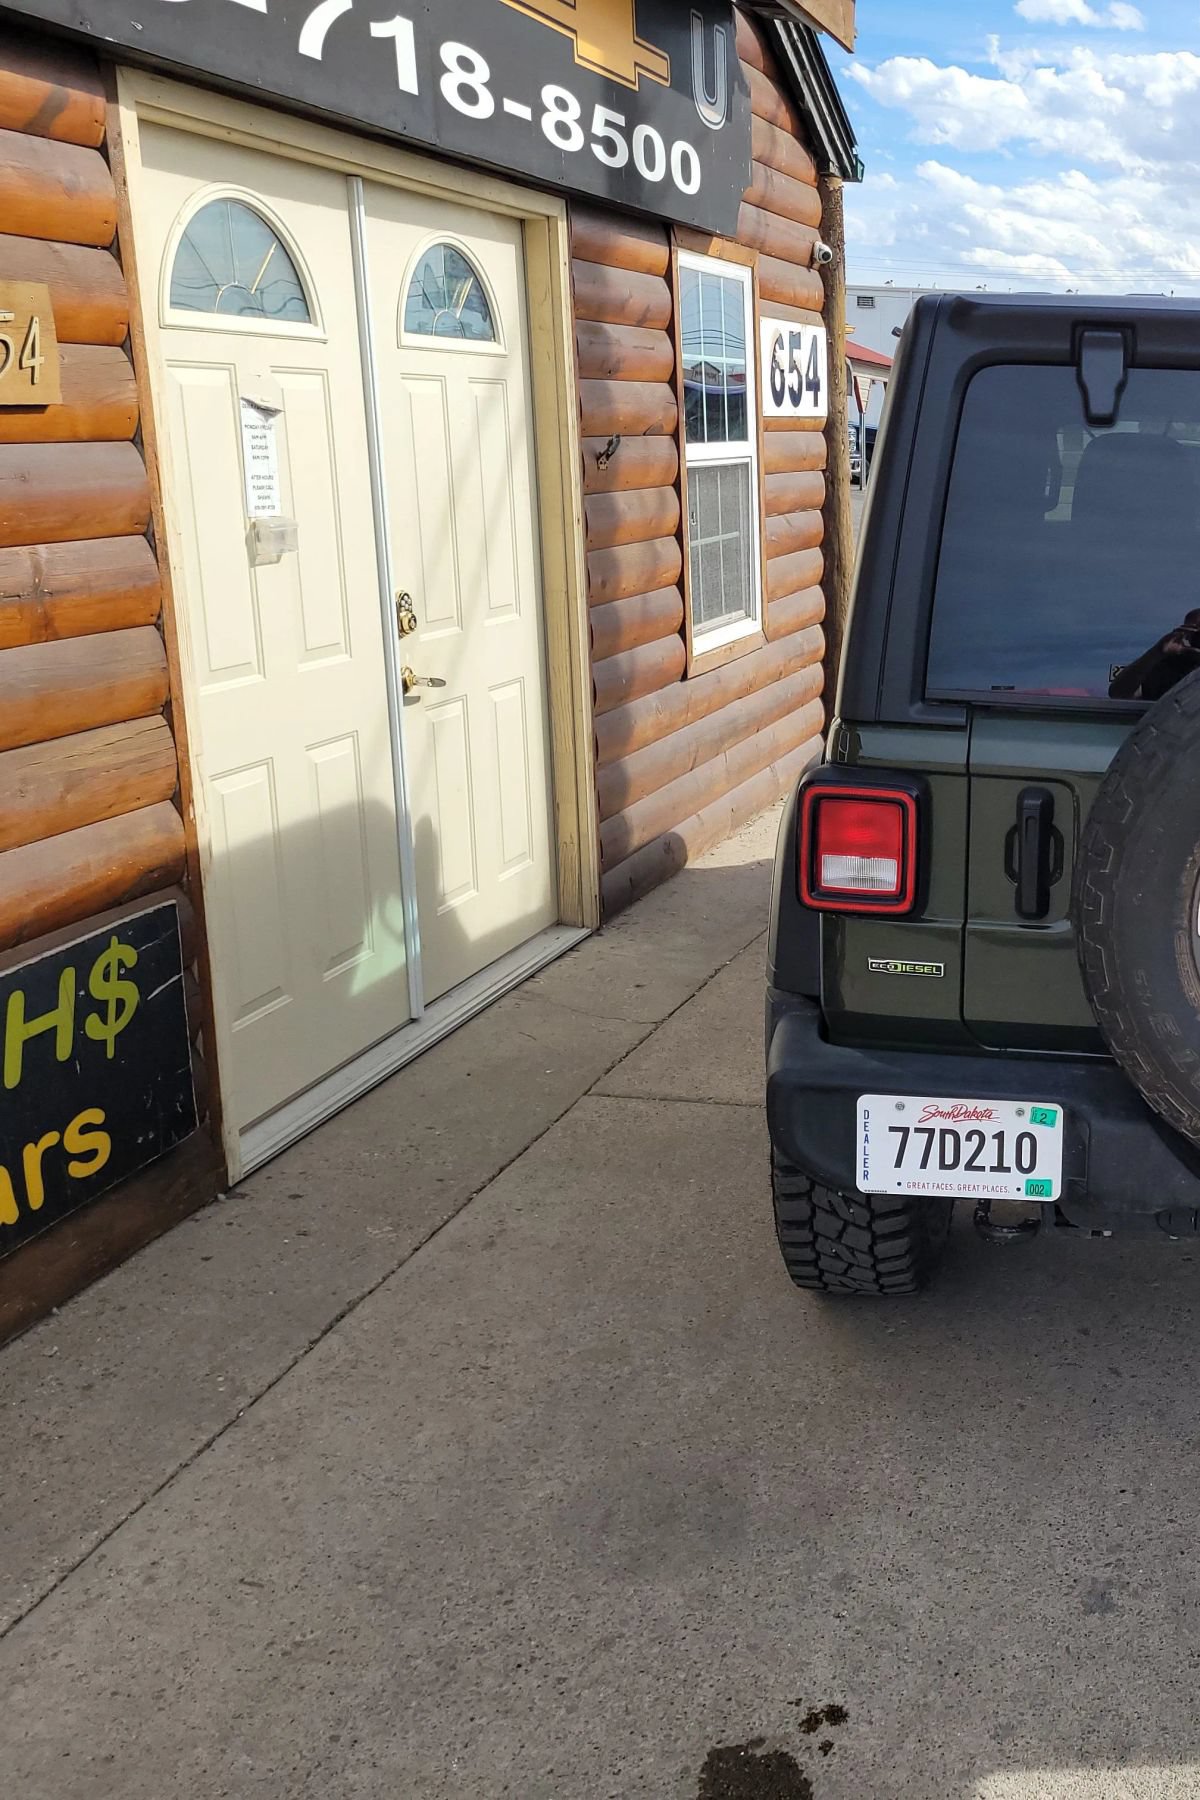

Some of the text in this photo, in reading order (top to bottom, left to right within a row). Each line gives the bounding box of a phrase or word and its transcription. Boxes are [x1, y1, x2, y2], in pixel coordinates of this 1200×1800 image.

[770, 328, 821, 408] 654
[918, 1104, 1001, 1123] South Dakota
[888, 1126, 1038, 1175] 77D210
[906, 1181, 1011, 1193] GREAT FACES. GREAT PLACES.
